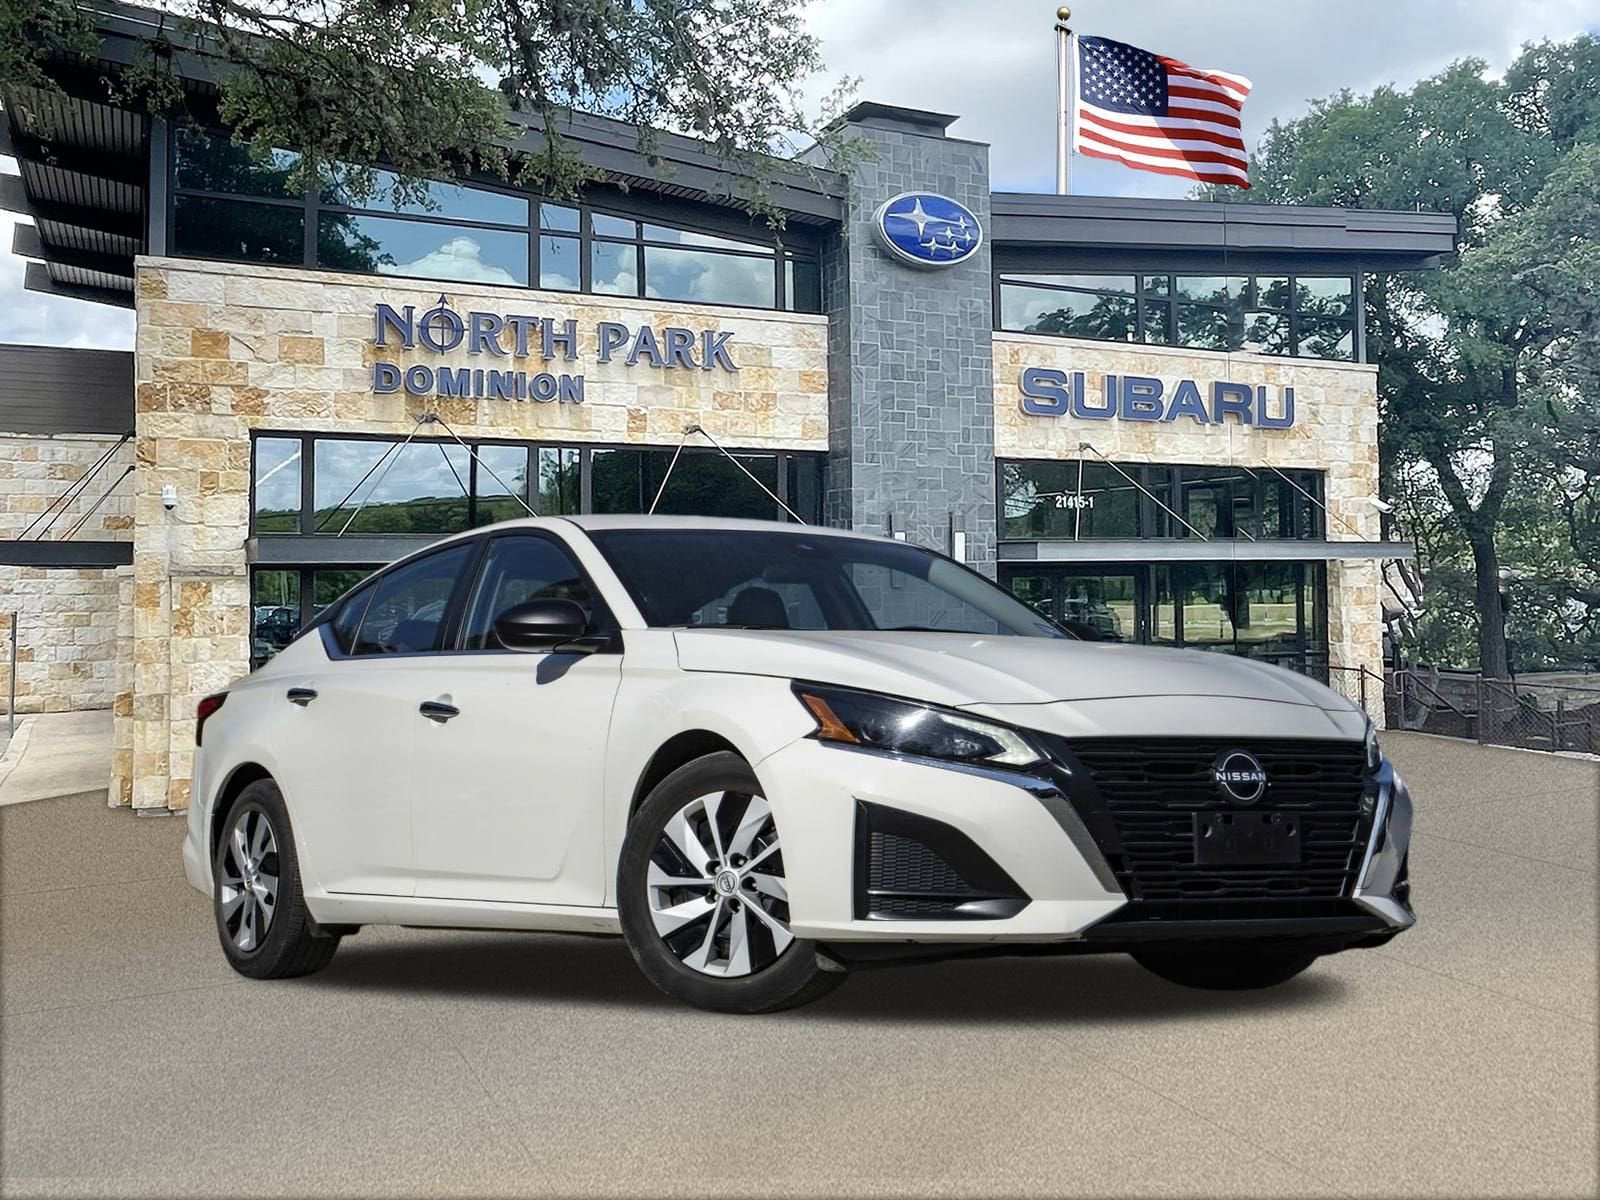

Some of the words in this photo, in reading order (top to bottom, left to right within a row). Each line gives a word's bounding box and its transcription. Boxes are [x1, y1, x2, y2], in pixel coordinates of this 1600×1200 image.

[374, 299, 579, 360] NORTH
[597, 321, 742, 373] PARK
[373, 361, 585, 404] DOMINION
[1019, 367, 1295, 430] SUBARU
[1215, 771, 1266, 782] NISSAN
